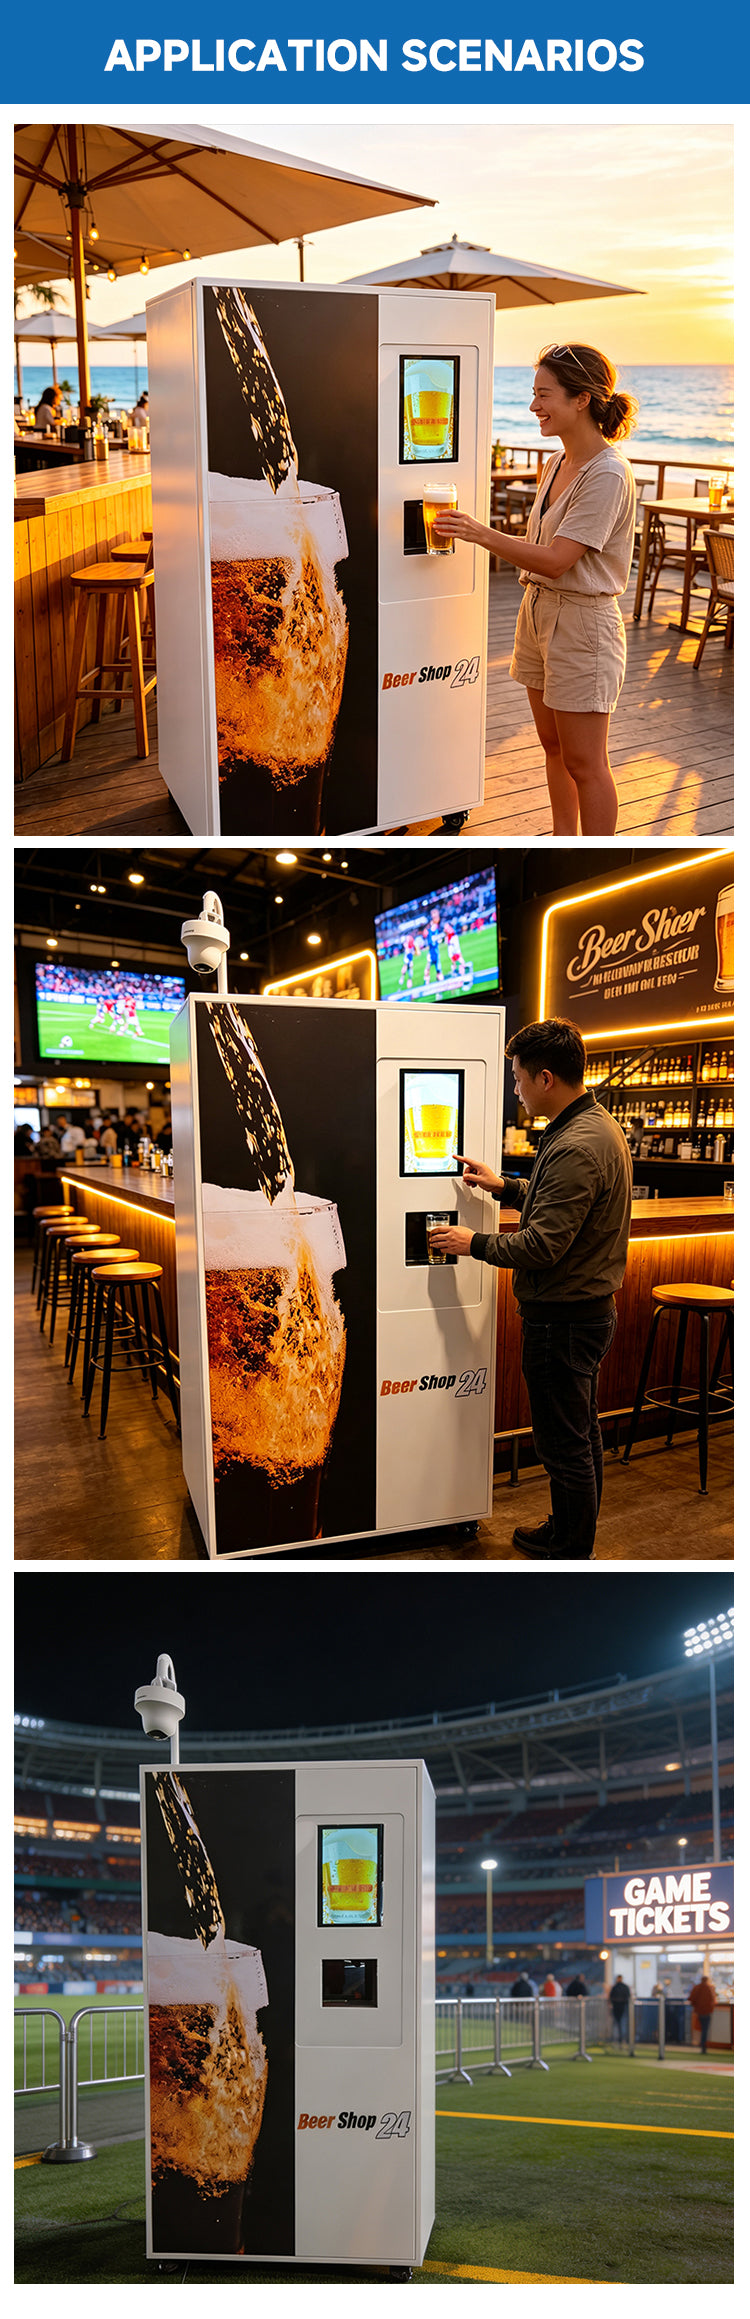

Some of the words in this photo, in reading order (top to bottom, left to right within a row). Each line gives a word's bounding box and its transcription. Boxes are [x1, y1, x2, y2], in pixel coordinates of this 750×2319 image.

[382, 672, 417, 690] Beer
[418, 665, 452, 683] Shop
[450, 656, 480, 688] 24
[566, 924, 637, 982] Beer
[380, 1380, 418, 1396] Beer
[418, 1375, 456, 1391] Shop
[455, 1368, 487, 1398] 24
[624, 1872, 712, 1906] GAME
[609, 1901, 730, 1936] TICKETS
[297, 2113, 336, 2130] Beer
[337, 2111, 377, 2131] Shop
[375, 2111, 412, 2139] 24
